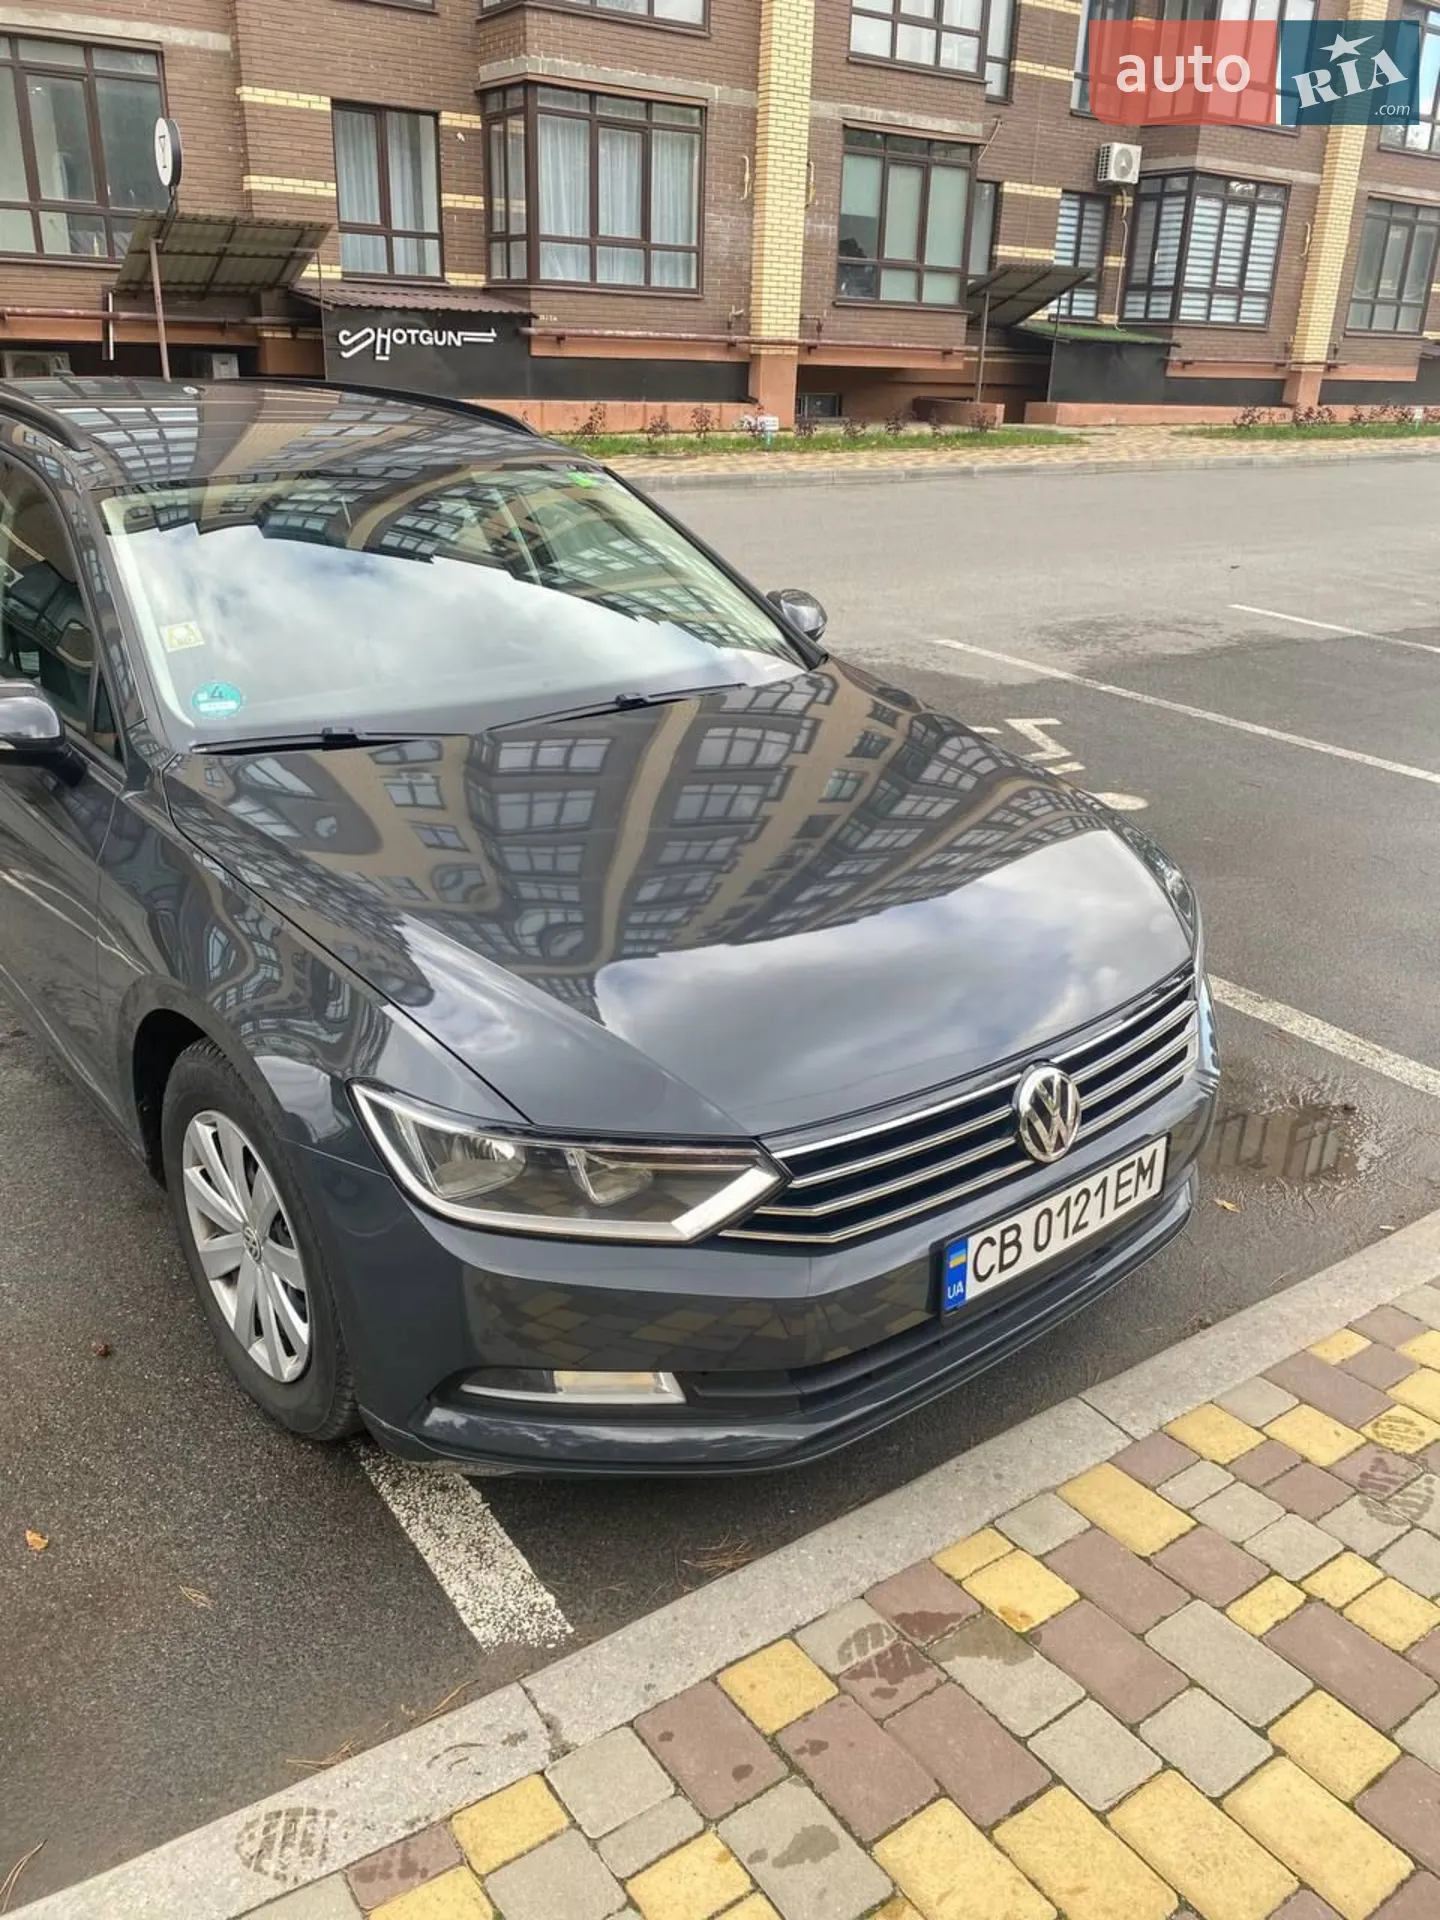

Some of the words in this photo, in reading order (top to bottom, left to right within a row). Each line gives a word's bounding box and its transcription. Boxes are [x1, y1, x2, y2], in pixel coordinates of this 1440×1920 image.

[338, 327, 464, 361] SHOTGUN
[1019, 1066, 1080, 1163] VW
[972, 1223, 1023, 1282] CB
[947, 1281, 964, 1299] UA
